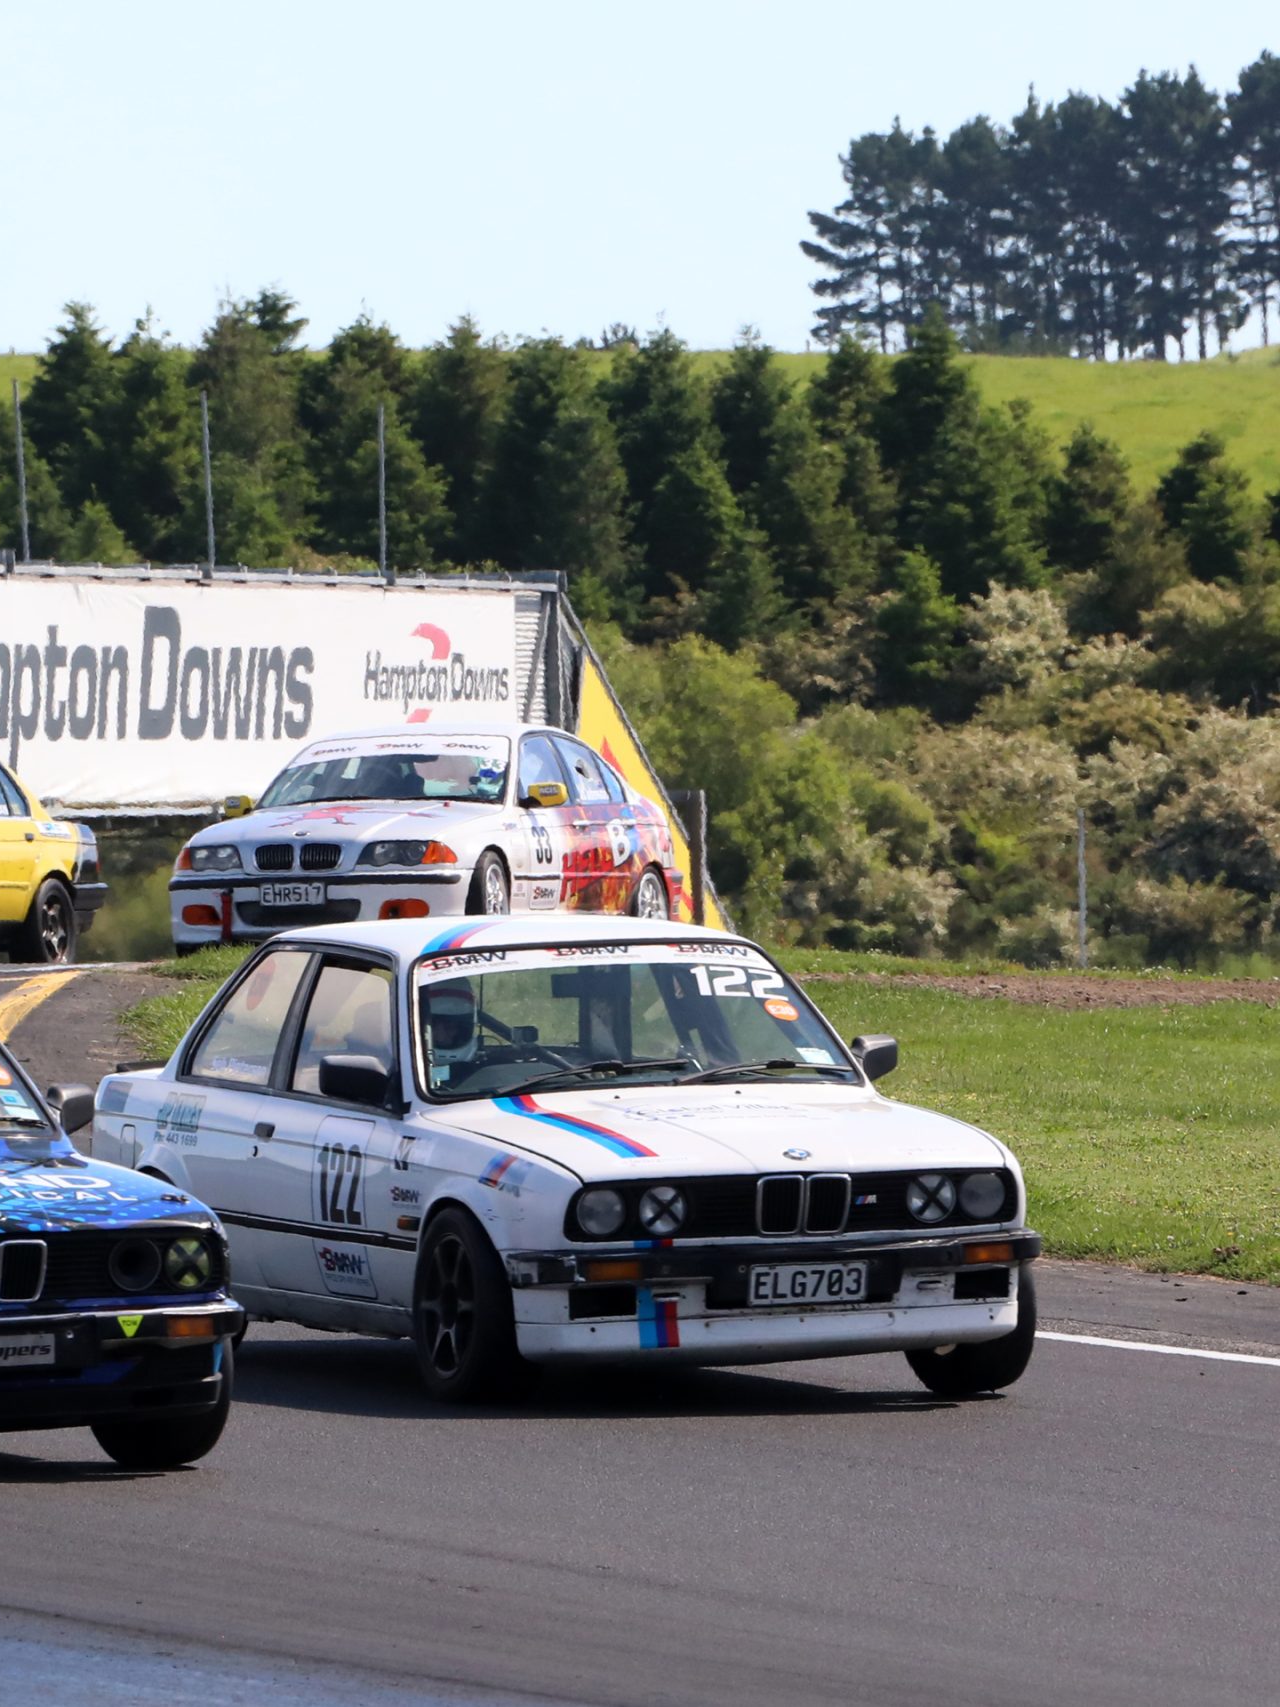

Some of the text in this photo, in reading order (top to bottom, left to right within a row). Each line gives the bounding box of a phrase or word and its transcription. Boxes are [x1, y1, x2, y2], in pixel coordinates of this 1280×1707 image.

[138, 605, 315, 741] Downs
[364, 649, 509, 714] Hampton Downs
[531, 826, 553, 864] 33
[262, 887, 322, 904] EHR517
[421, 951, 506, 970] BMW
[668, 944, 748, 957] BMW
[689, 965, 789, 1001] 122
[166, 1131, 179, 1144] 443
[318, 1143, 362, 1226] 122
[390, 1186, 420, 1203] BMW
[320, 1247, 363, 1275] BMW
[753, 1267, 864, 1299] ELG703
